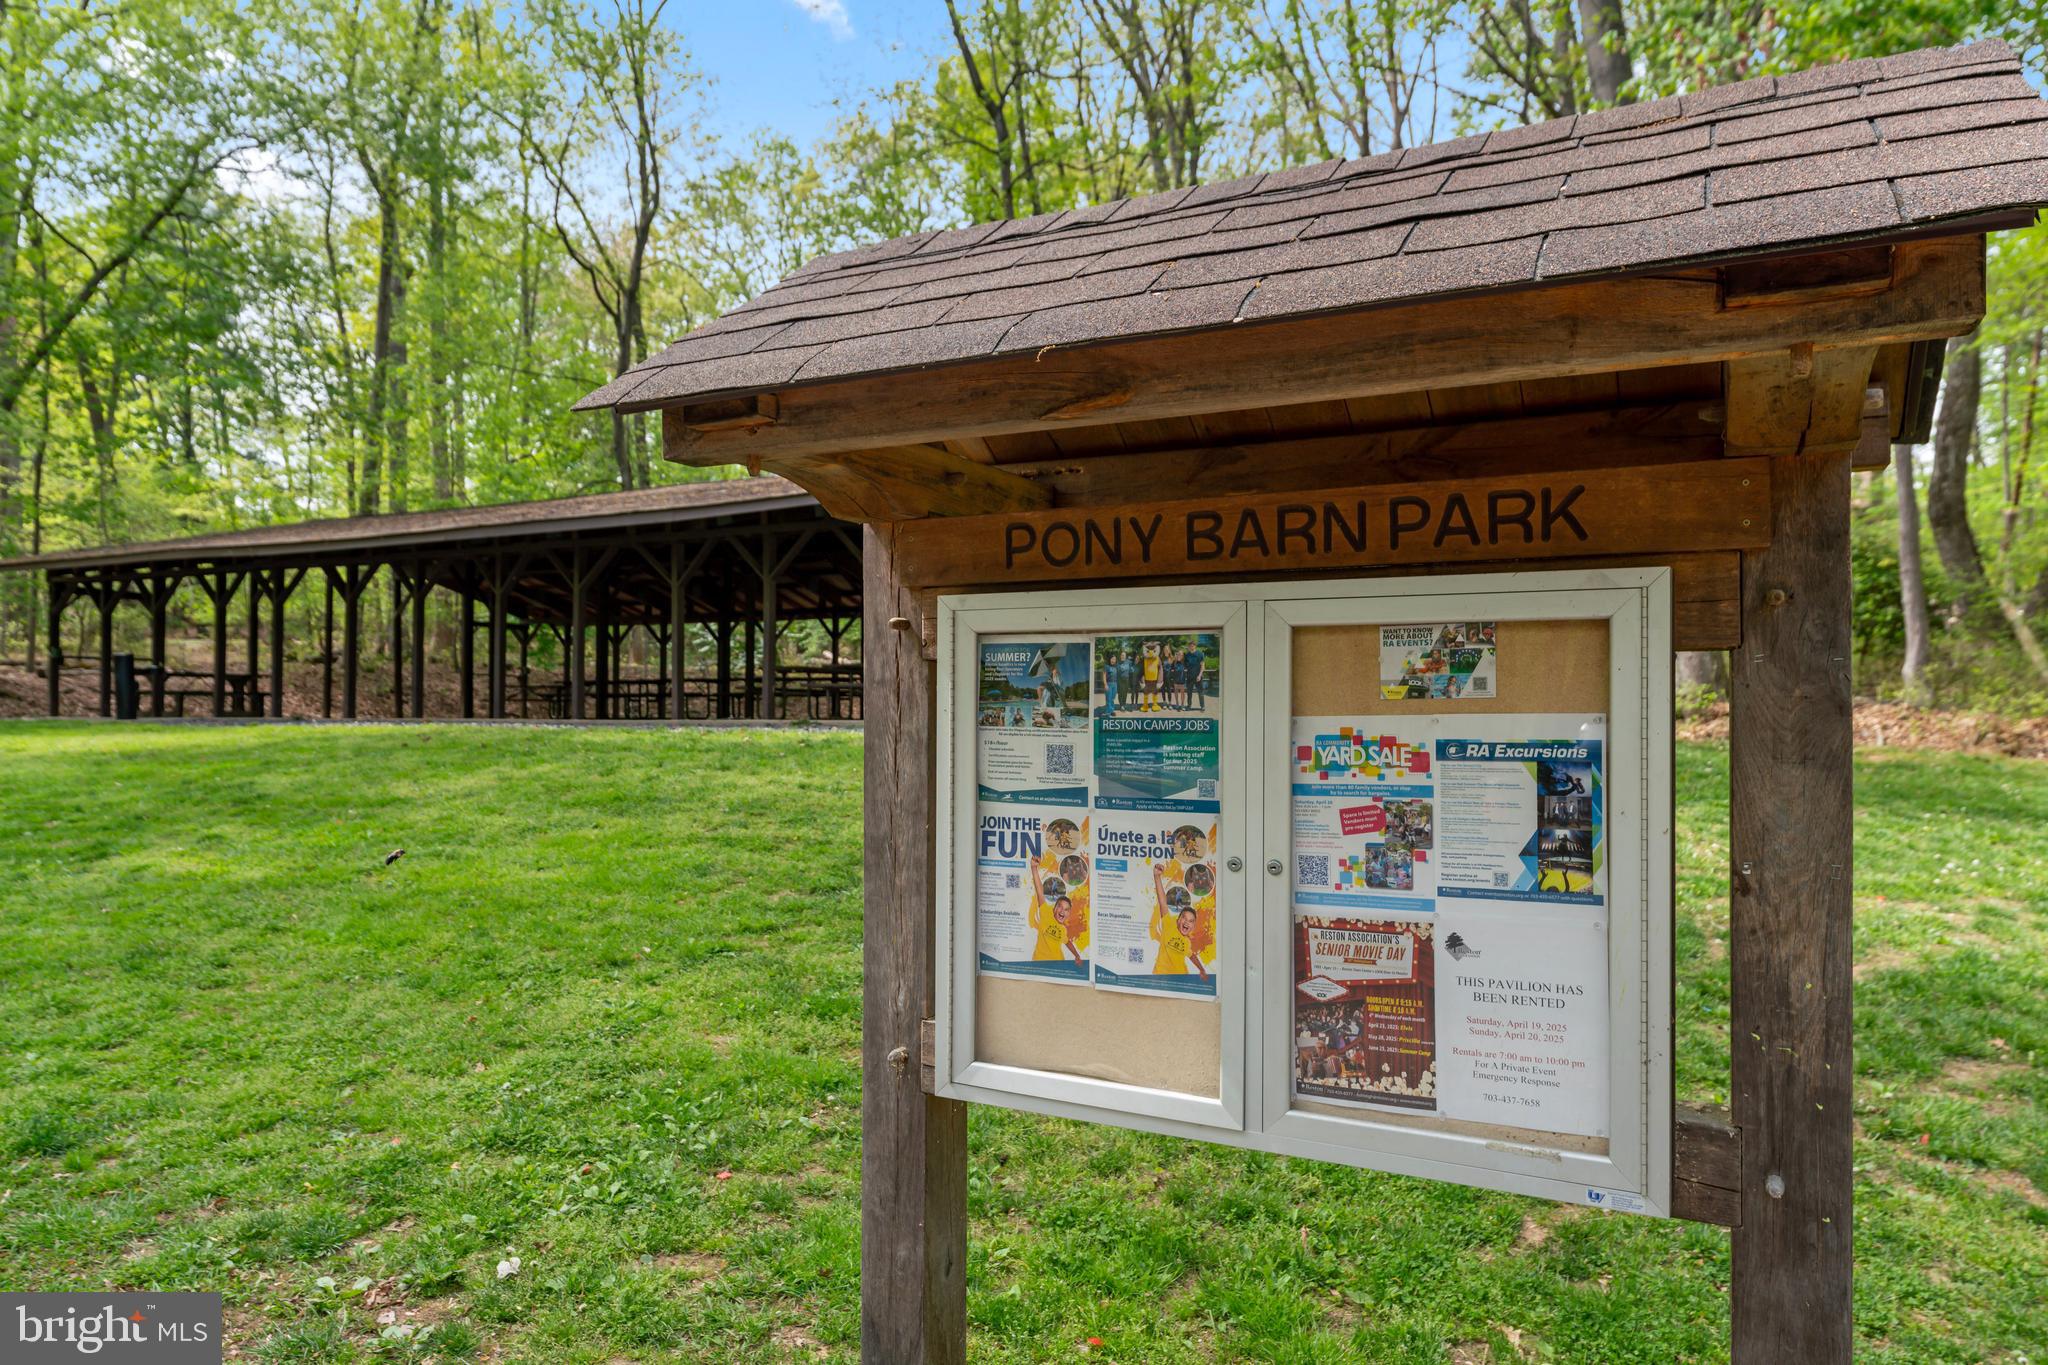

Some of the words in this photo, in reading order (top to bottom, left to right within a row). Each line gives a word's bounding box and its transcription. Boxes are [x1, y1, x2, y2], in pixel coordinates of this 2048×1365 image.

[1004, 513, 1163, 570] PONY
[1186, 500, 1368, 562] BARN
[1388, 484, 1590, 551] PARK
[1396, 639, 1433, 647] EVENTS?
[985, 652, 1031, 662] SUMMER?
[1102, 720, 1142, 730] RESTON
[1144, 720, 1182, 730] CAMPS
[1184, 720, 1210, 731] JOBS
[1317, 746, 1366, 766] YARD
[1368, 746, 1412, 767] SALE
[1466, 744, 1489, 757] RA
[1494, 744, 1588, 758] Excursions
[980, 816, 1011, 830] JOIN
[1013, 817, 1041, 831] THE
[1098, 824, 1144, 843] Únete
[1148, 834, 1156, 844] a
[1161, 830, 1175, 844] la
[981, 830, 1041, 859] FUN
[1097, 844, 1175, 859] DIVERSION
[1320, 930, 1345, 941] RESTON
[1348, 931, 1400, 944] ASSOCIATION'S
[1316, 942, 1351, 957] SENIOR
[1353, 944, 1383, 960] MOVIE
[1386, 947, 1406, 960] DAY
[1456, 976, 1485, 988] THIS
[1488, 978, 1551, 993] PAVILION
[1556, 984, 1584, 996] HAS
[1473, 992, 1508, 1004] BEEN
[1511, 994, 1566, 1009] RENTED
[1466, 1016, 1504, 1027] Saturday,
[1508, 1019, 1528, 1030] April
[1531, 1022, 1544, 1031] 19,
[1546, 1023, 1567, 1032] 2025
[1469, 1027, 1501, 1039] Sunday,
[1504, 1030, 1526, 1041] April
[1528, 1033, 1541, 1042] 20,
[1544, 1035, 1565, 1044] 2025
[1452, 1047, 1482, 1058] Rentals
[1500, 1052, 1517, 1061] 7:00
[1534, 1056, 1543, 1064] to
[1546, 1056, 1569, 1066] 10:00
[1572, 1061, 1585, 1069] pm
[1475, 1060, 1489, 1068] For
[1491, 1062, 1498, 1070] A
[1501, 1063, 1530, 1074] Private
[1532, 1067, 1556, 1077] Event
[1472, 1070, 1518, 1084] Emergency
[1520, 1077, 1561, 1088] Response
[1483, 1094, 1541, 1108] 703-437-7658
